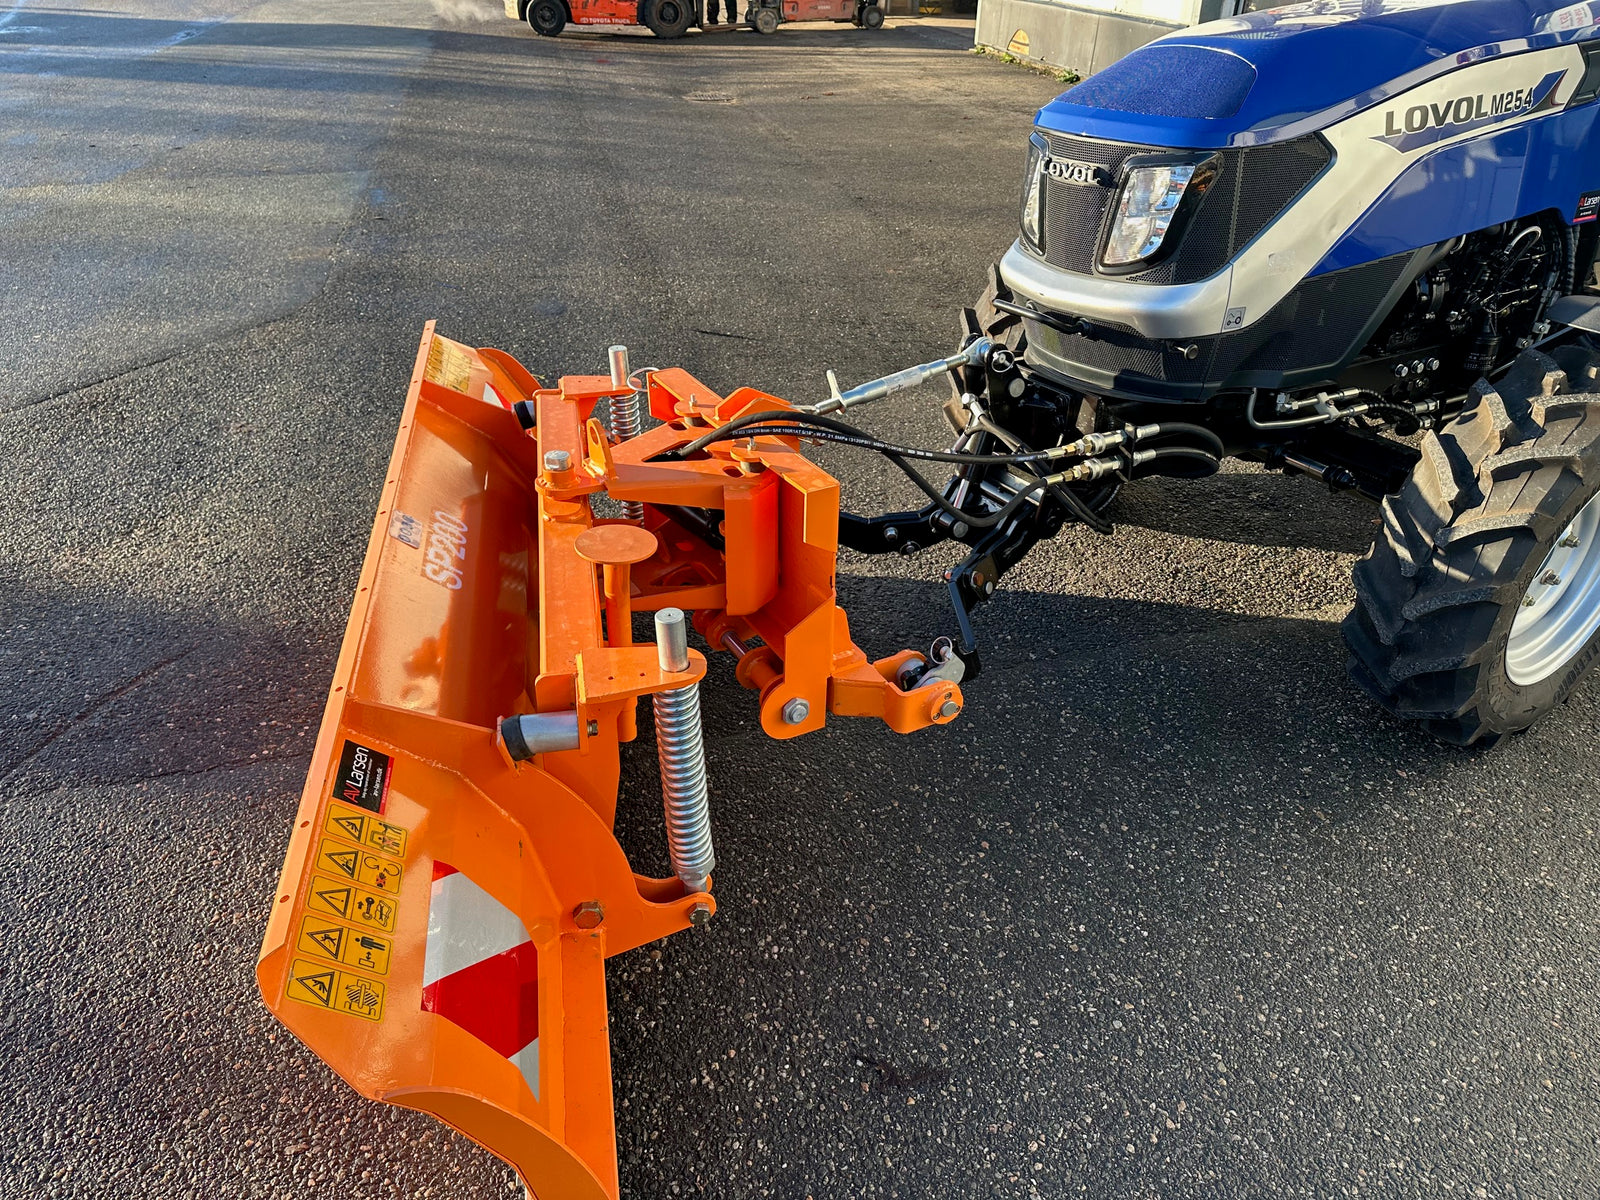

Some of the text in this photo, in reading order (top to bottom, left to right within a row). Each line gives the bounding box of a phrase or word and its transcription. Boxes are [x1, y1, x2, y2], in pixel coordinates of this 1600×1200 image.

[1384, 87, 1534, 136] LOVOL M254
[1040, 157, 1101, 183] LOVOL
[425, 511, 469, 590] SP200
